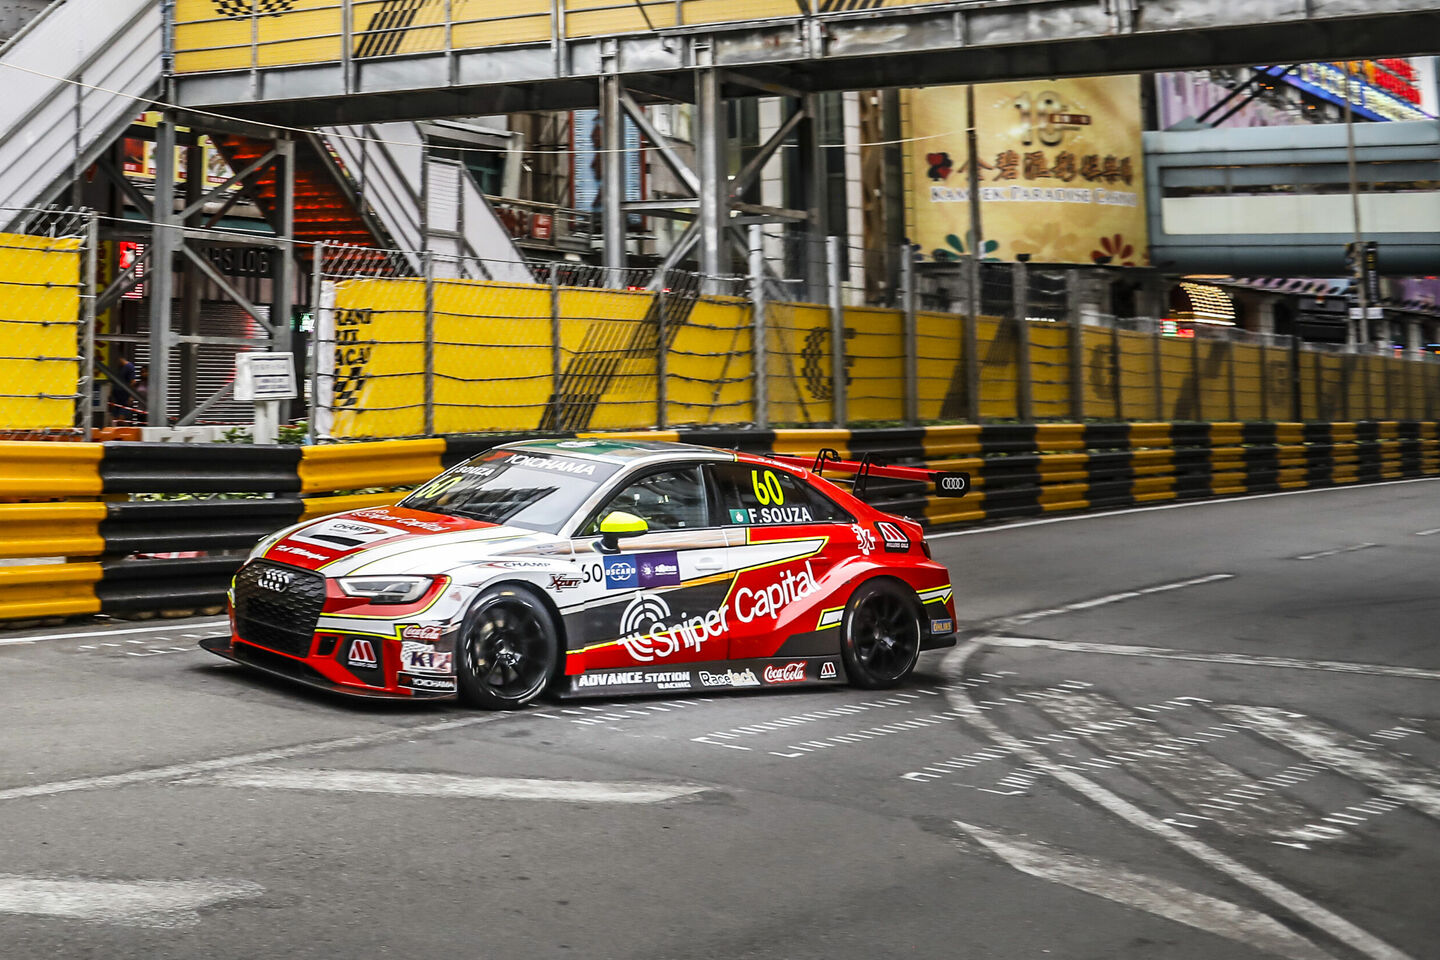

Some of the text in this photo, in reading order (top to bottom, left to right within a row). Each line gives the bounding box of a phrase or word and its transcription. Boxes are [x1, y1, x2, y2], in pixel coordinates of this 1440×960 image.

[505, 454, 596, 476] YOKOHAMA
[751, 469, 785, 506] 60
[748, 507, 813, 524] F.SOUZA
[649, 560, 822, 657] Sniper Capital
[578, 671, 691, 687] ADVANCE STATION
